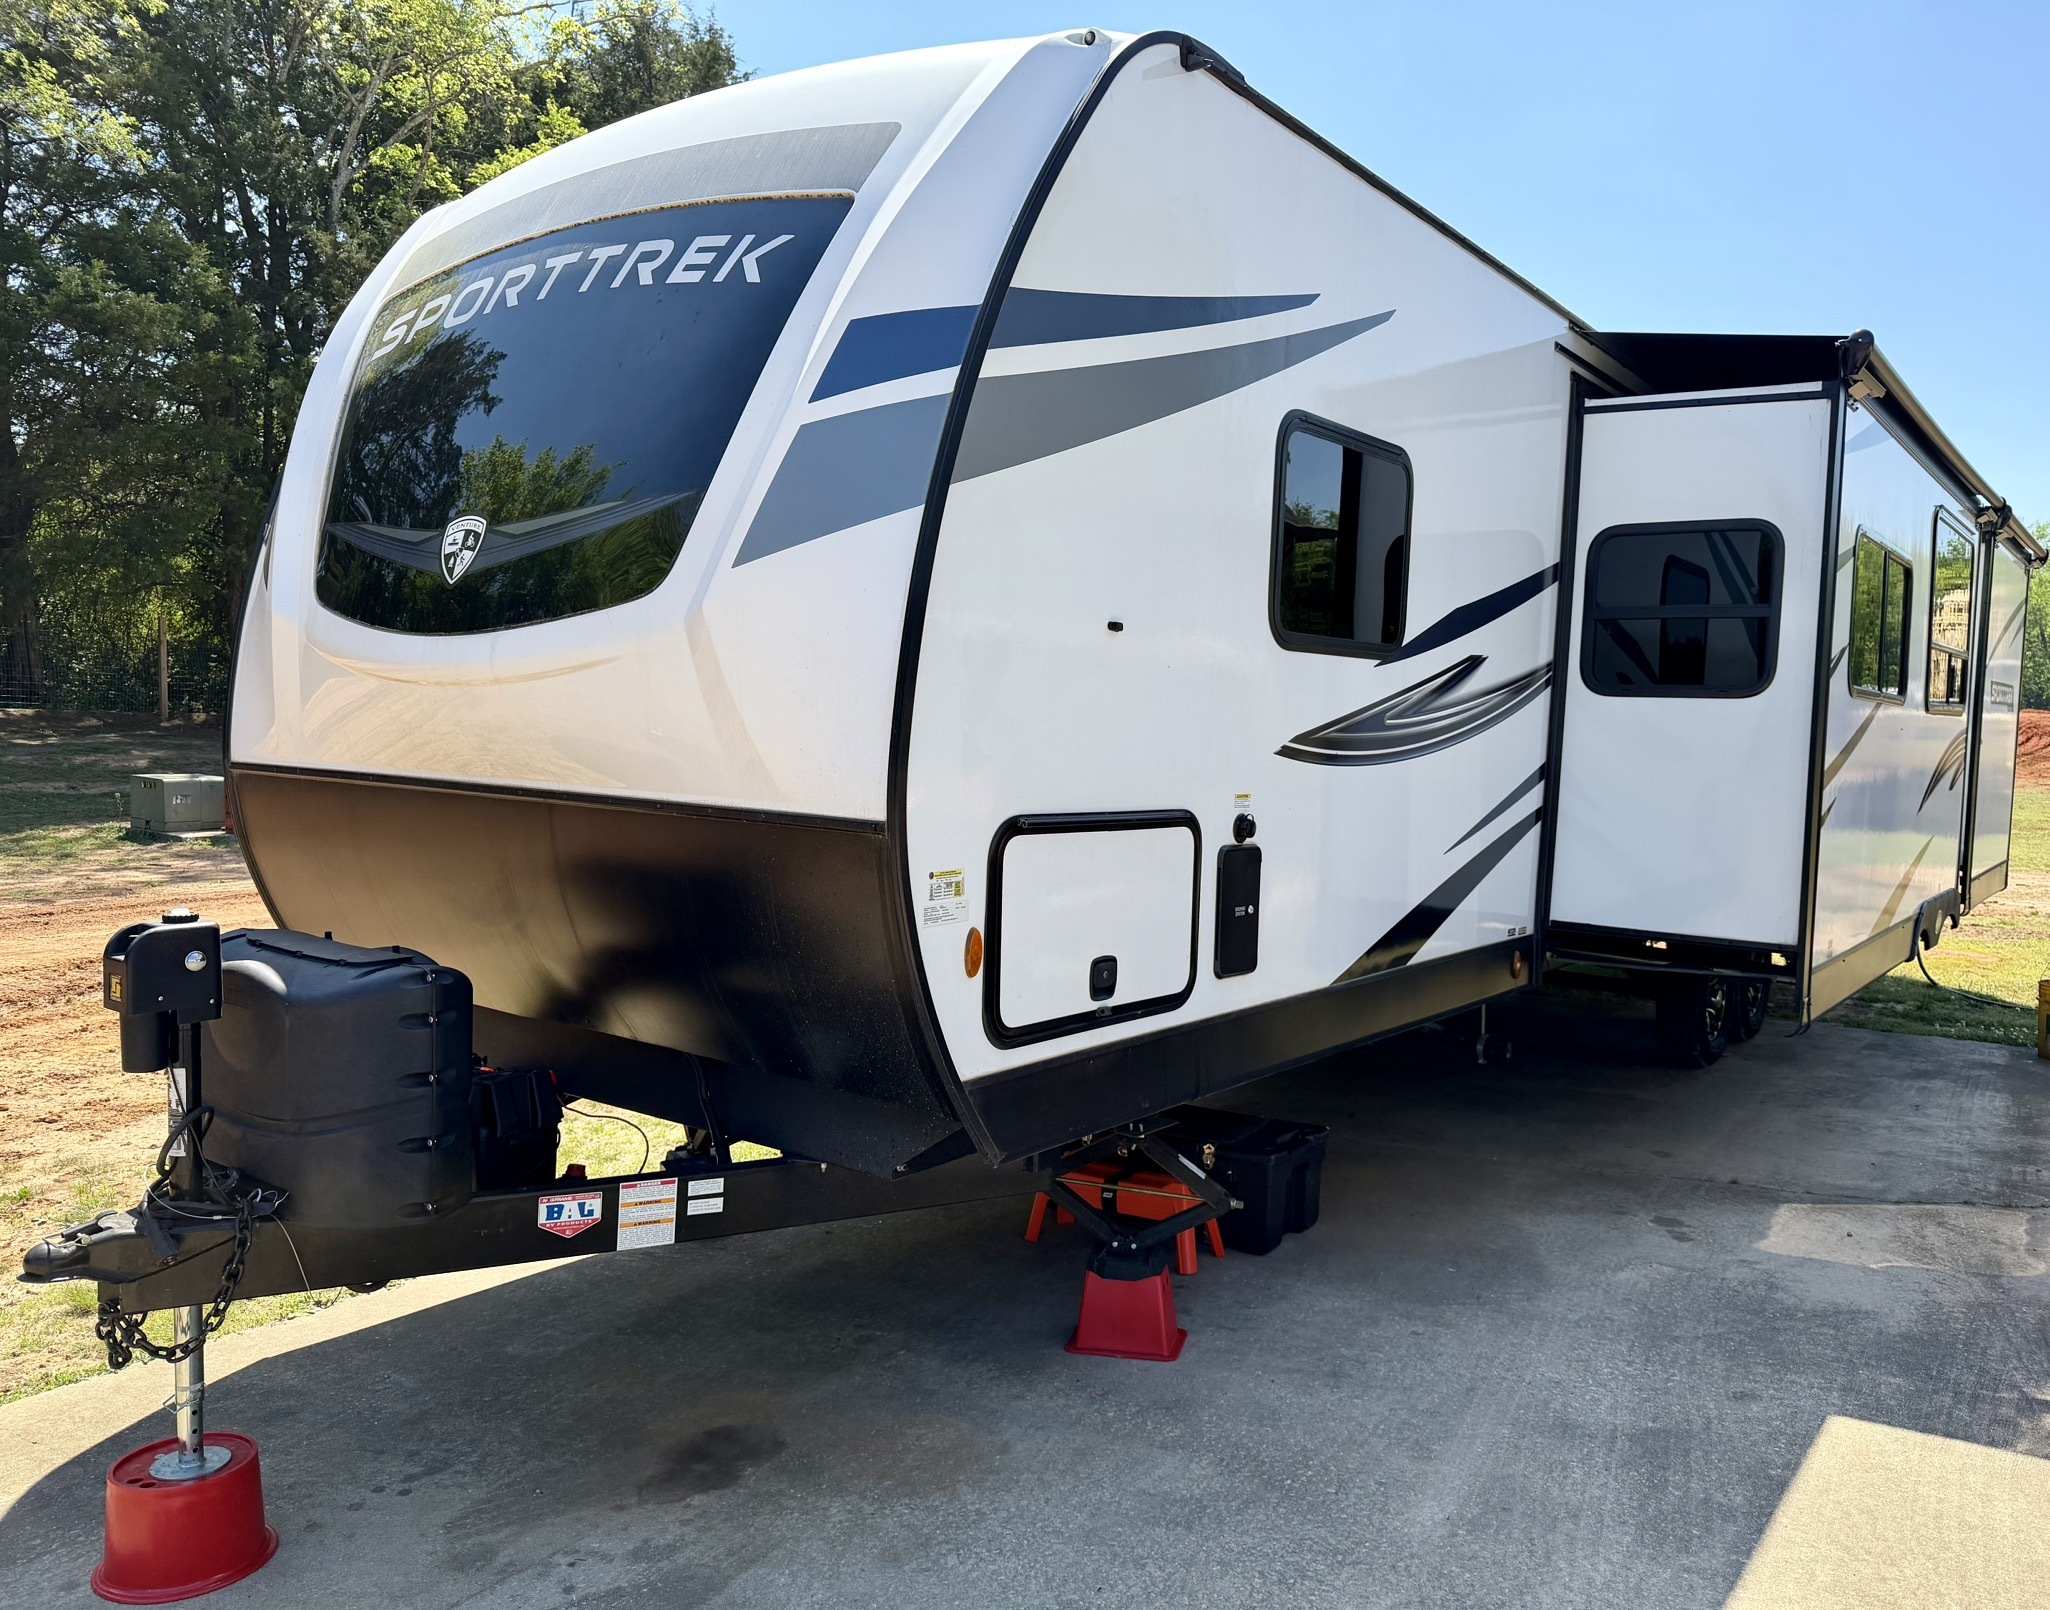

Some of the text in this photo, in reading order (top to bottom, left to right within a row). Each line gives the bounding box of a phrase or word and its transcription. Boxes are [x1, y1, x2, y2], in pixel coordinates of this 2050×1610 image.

[371, 234, 795, 361] SPORTTREK
[451, 522, 481, 531] VENTURE
[545, 1202, 595, 1221] BAL
[557, 1219, 592, 1227] PRODUCTS
